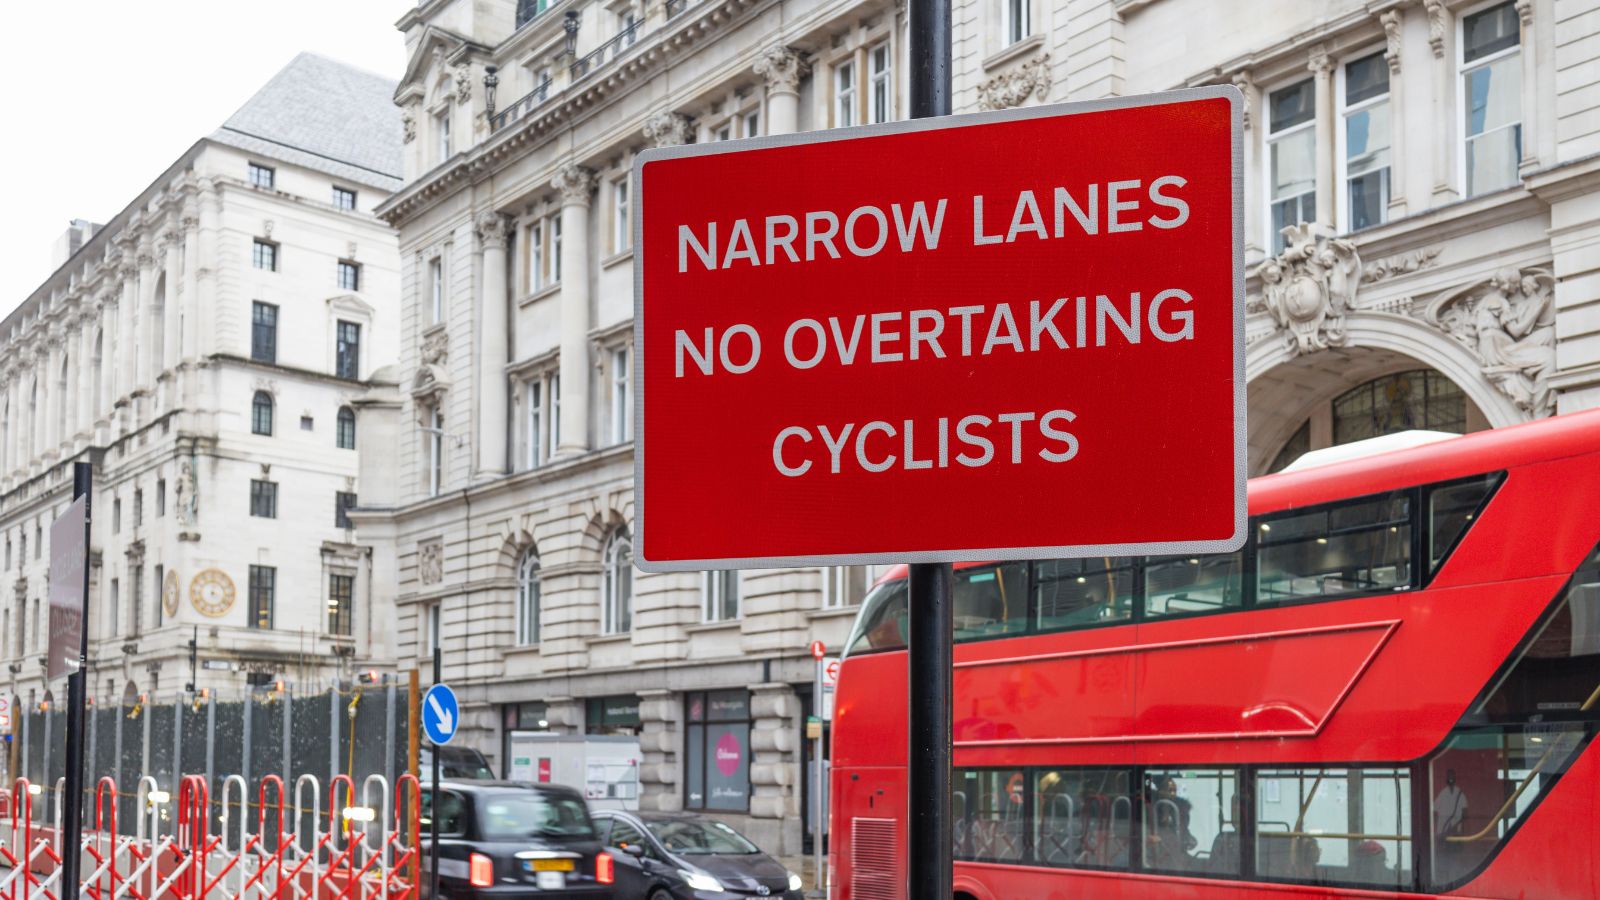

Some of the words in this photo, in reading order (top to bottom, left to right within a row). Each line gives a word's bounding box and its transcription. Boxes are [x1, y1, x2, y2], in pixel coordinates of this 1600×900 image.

[678, 198, 948, 273] NARROW
[973, 175, 1190, 246] LANES
[675, 323, 762, 378] NO
[783, 288, 1195, 370] OVERTAKING
[772, 409, 1079, 477] CYCLISTS
[814, 642, 824, 657] L
